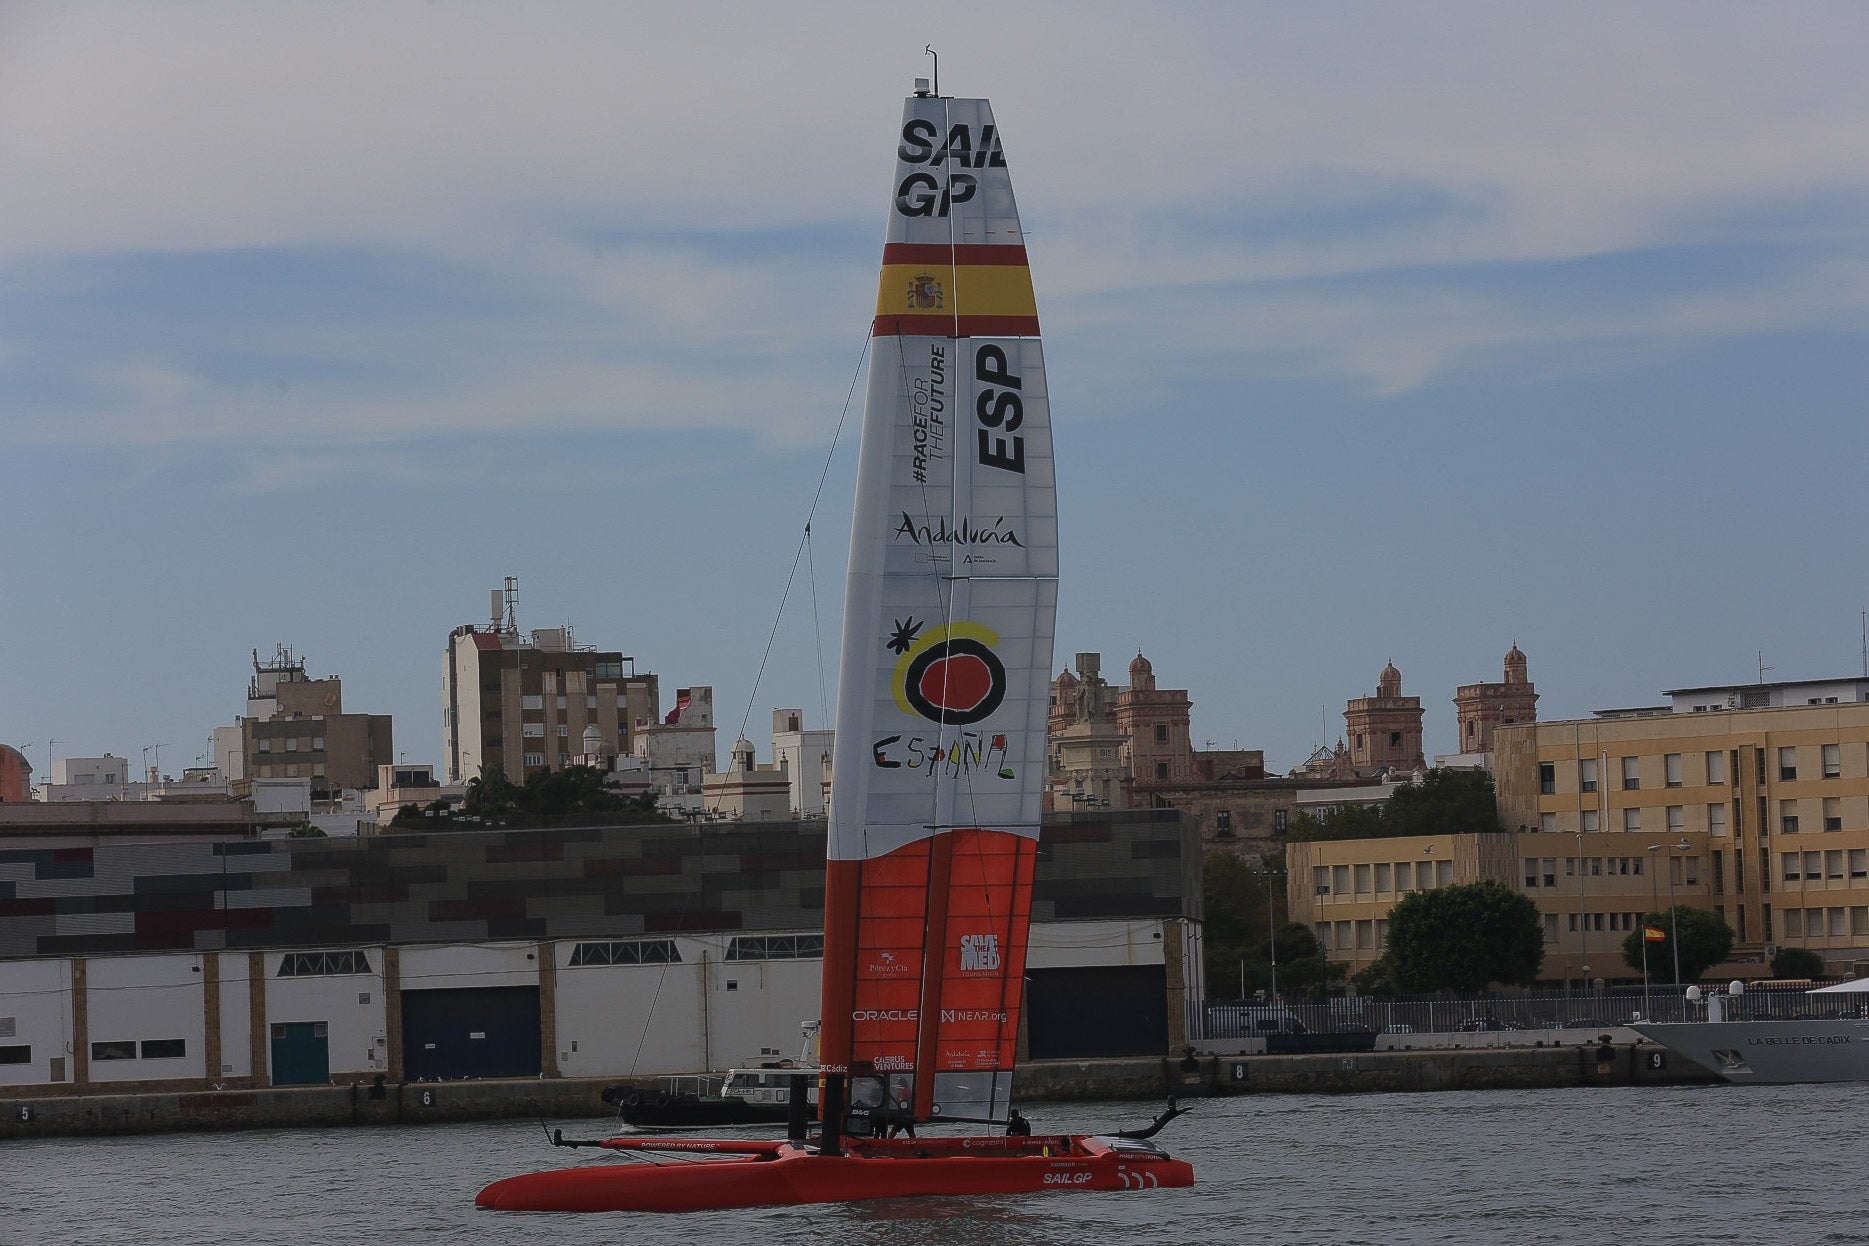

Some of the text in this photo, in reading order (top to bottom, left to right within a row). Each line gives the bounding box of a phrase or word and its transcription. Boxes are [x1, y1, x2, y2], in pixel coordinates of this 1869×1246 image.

[895, 173, 977, 217] GP
[976, 344, 1026, 474] ESP
[894, 511, 1026, 548] Andalucía
[873, 729, 1015, 779] ESPAÑA
[960, 935, 998, 952] SAVE
[961, 952, 1000, 970] MED
[852, 1010, 918, 1021] ORACLE
[958, 1011, 1007, 1022] NEAR.org
[1765, 1037, 1800, 1045] BELLE
[874, 1062, 914, 1071] VENTURES
[1653, 1053, 1661, 1068] 9
[826, 1064, 848, 1073] Cádiz
[1236, 1065, 1244, 1079] 8
[423, 1091, 431, 1105] 6
[22, 1106, 29, 1120] 5
